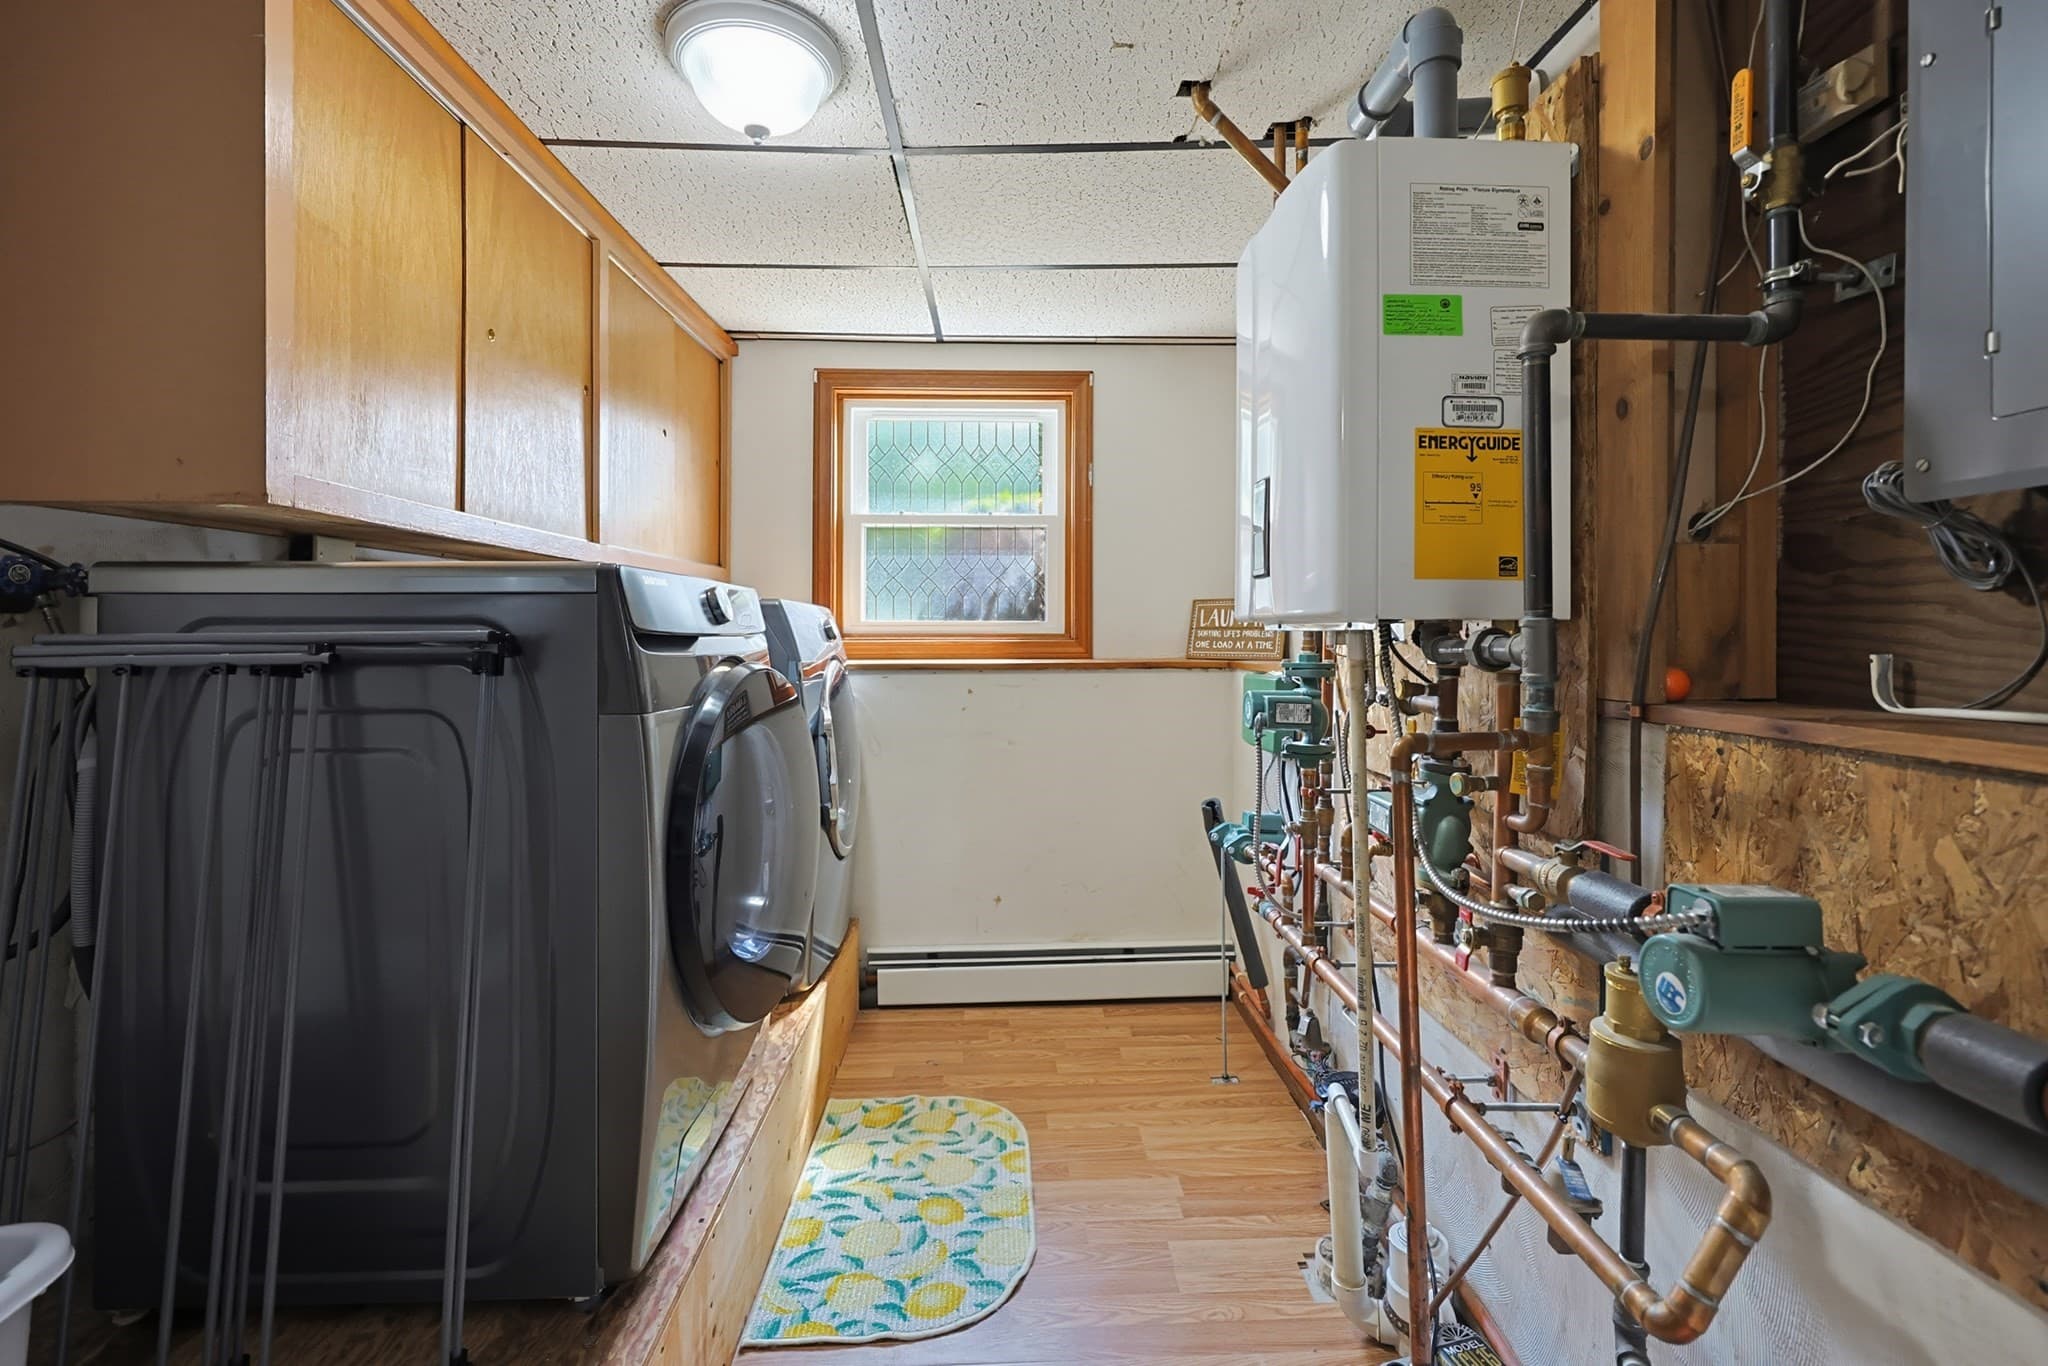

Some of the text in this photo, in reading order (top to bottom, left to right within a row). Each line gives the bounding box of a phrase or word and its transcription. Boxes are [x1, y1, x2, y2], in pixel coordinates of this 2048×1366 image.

[1469, 482, 1482, 492] 95
[1195, 640, 1274, 650] ONE LOAD AT A TIME
[1443, 1340, 1485, 1355] MODEL
